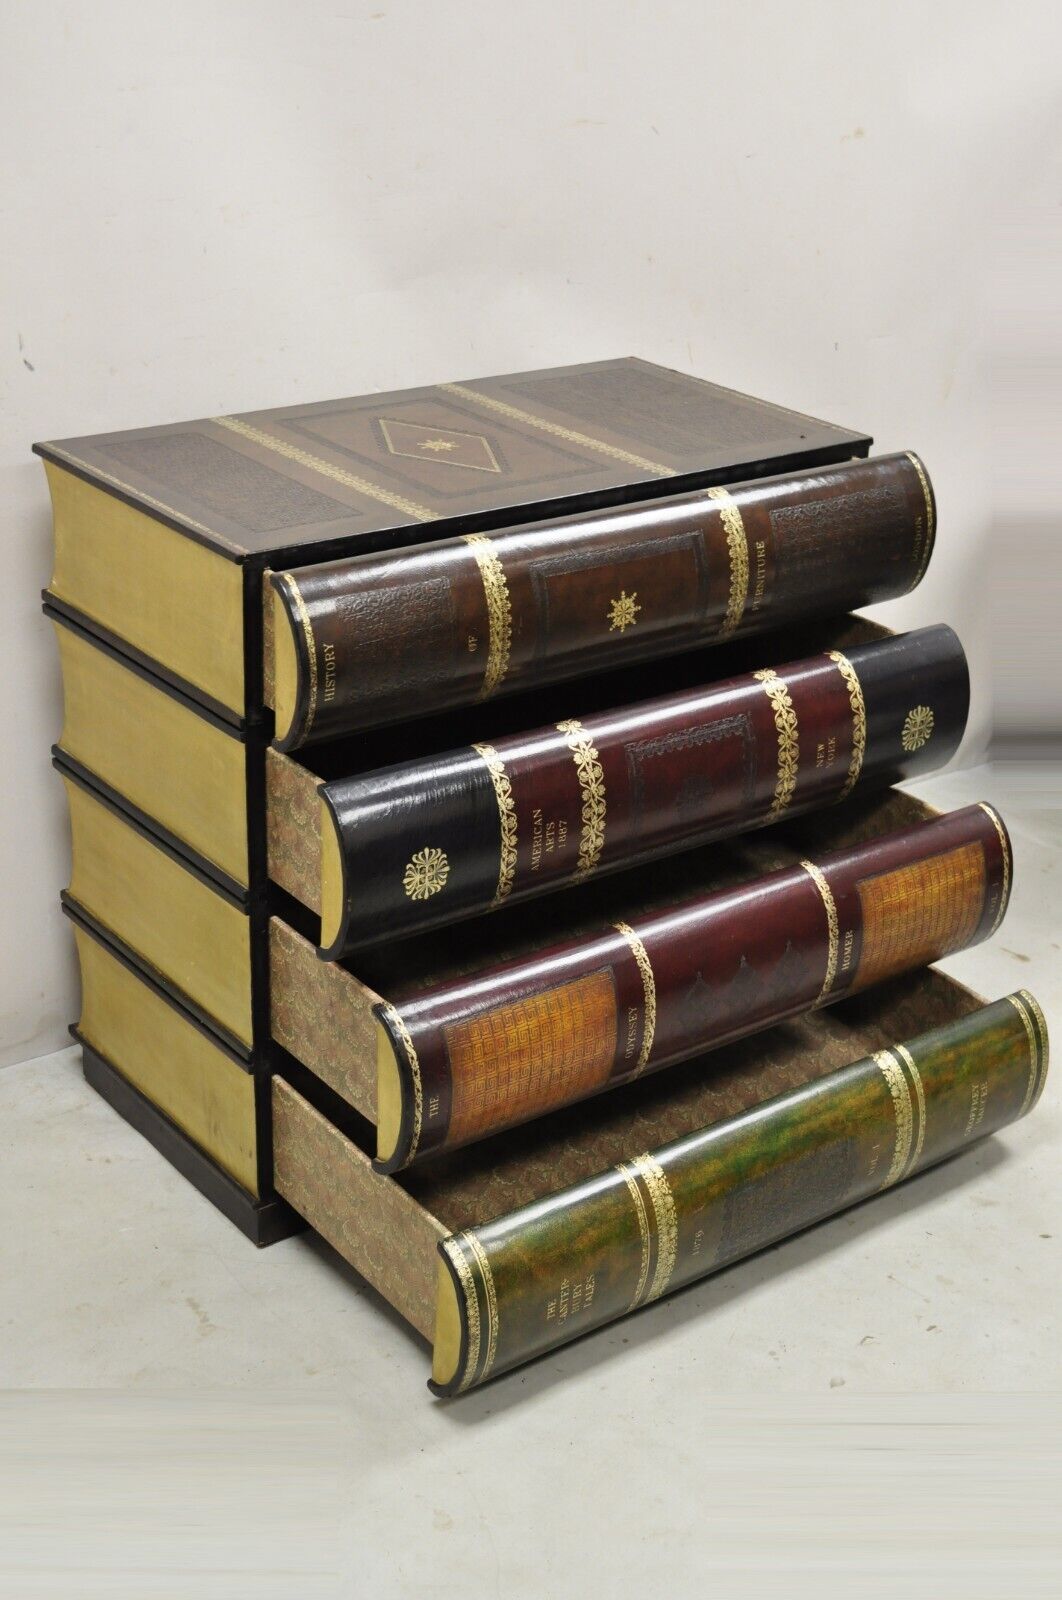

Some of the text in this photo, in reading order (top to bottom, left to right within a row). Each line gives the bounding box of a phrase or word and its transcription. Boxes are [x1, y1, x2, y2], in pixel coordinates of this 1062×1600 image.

[468, 635, 478, 652] OF
[322, 643, 336, 702] HISTORY
[816, 744, 825, 768] NEW
[825, 737, 836, 769] YORK
[531, 809, 543, 871] AMERICAN
[545, 821, 555, 852] ARTS
[558, 820, 568, 848] 1887
[841, 930, 853, 971] HOMER
[624, 1007, 638, 1059] ODYSSEY
[429, 1095, 439, 1118] THE
[583, 1274, 595, 1309] TALES
[546, 1299, 556, 1320] THE
